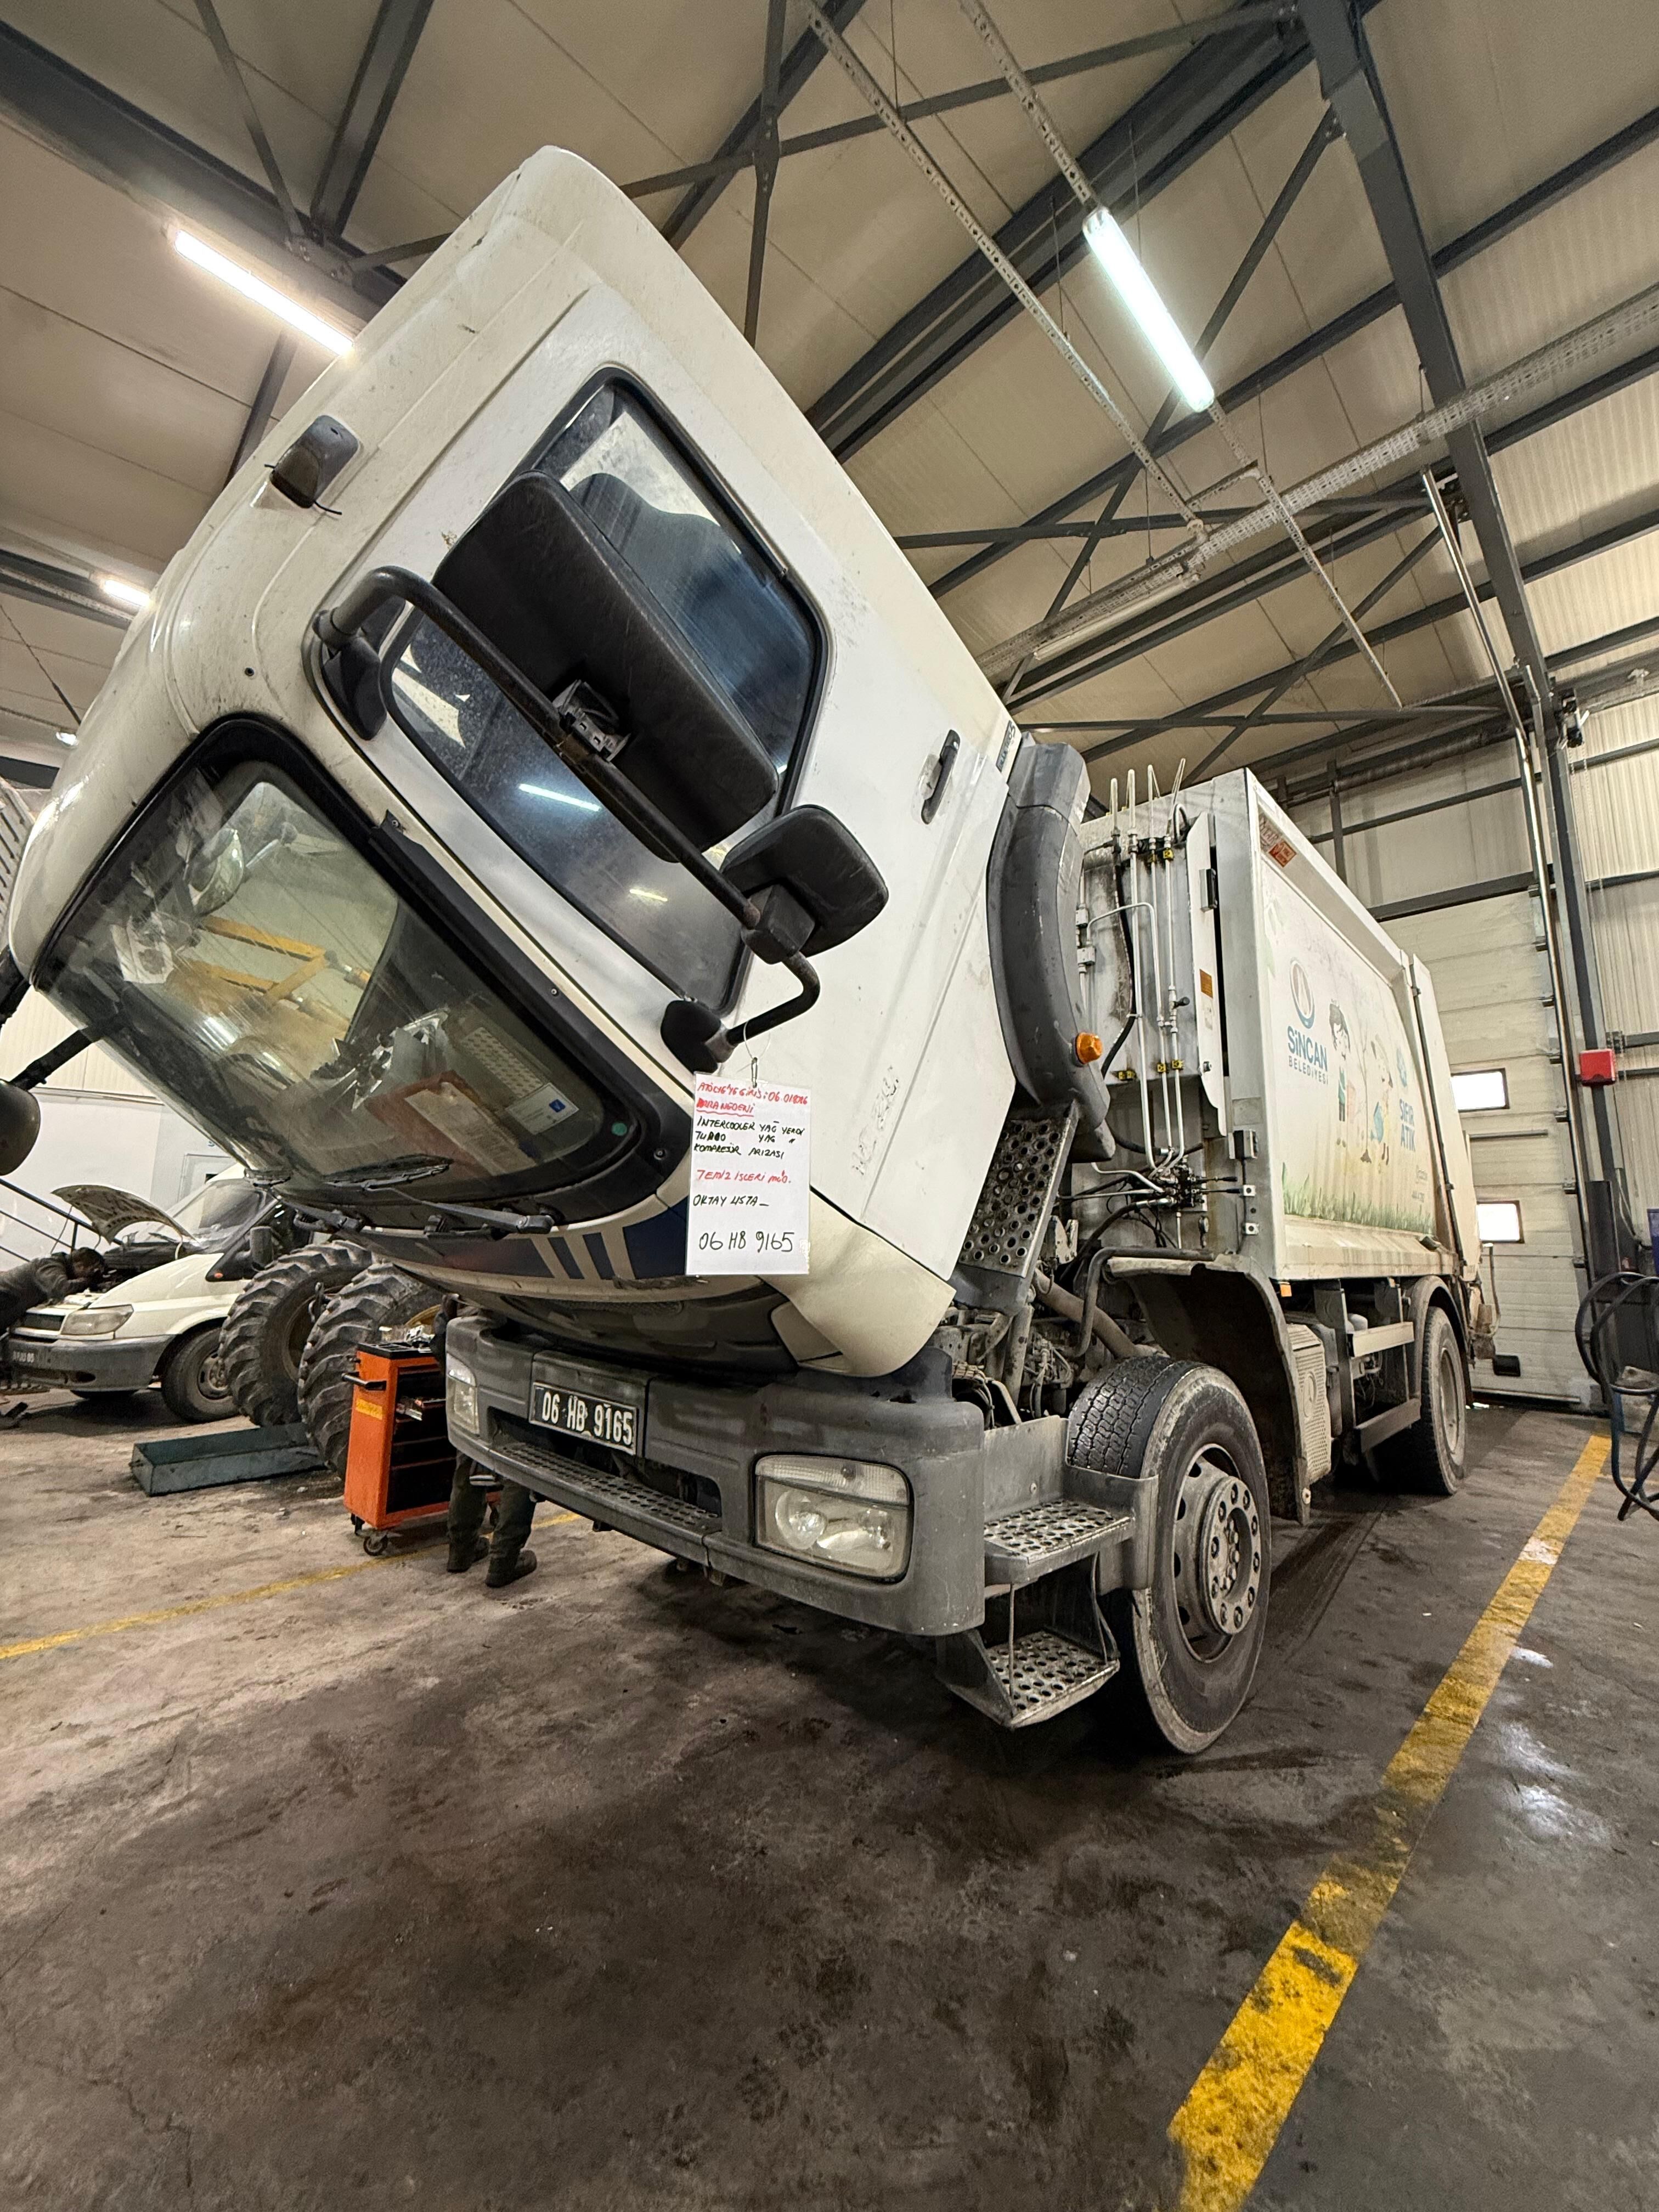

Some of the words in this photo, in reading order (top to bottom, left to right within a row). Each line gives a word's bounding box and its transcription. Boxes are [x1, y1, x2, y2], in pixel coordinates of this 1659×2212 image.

[1400, 1123, 1416, 1152] ATIK
[693, 1194, 727, 1207] OKTAY
[698, 1231, 724, 1250] 06
[728, 1231, 747, 1249] HB
[755, 1231, 795, 1253] 9165
[541, 1391, 561, 1424] 06
[566, 1395, 589, 1432] HB
[593, 1404, 633, 1446] 9165
